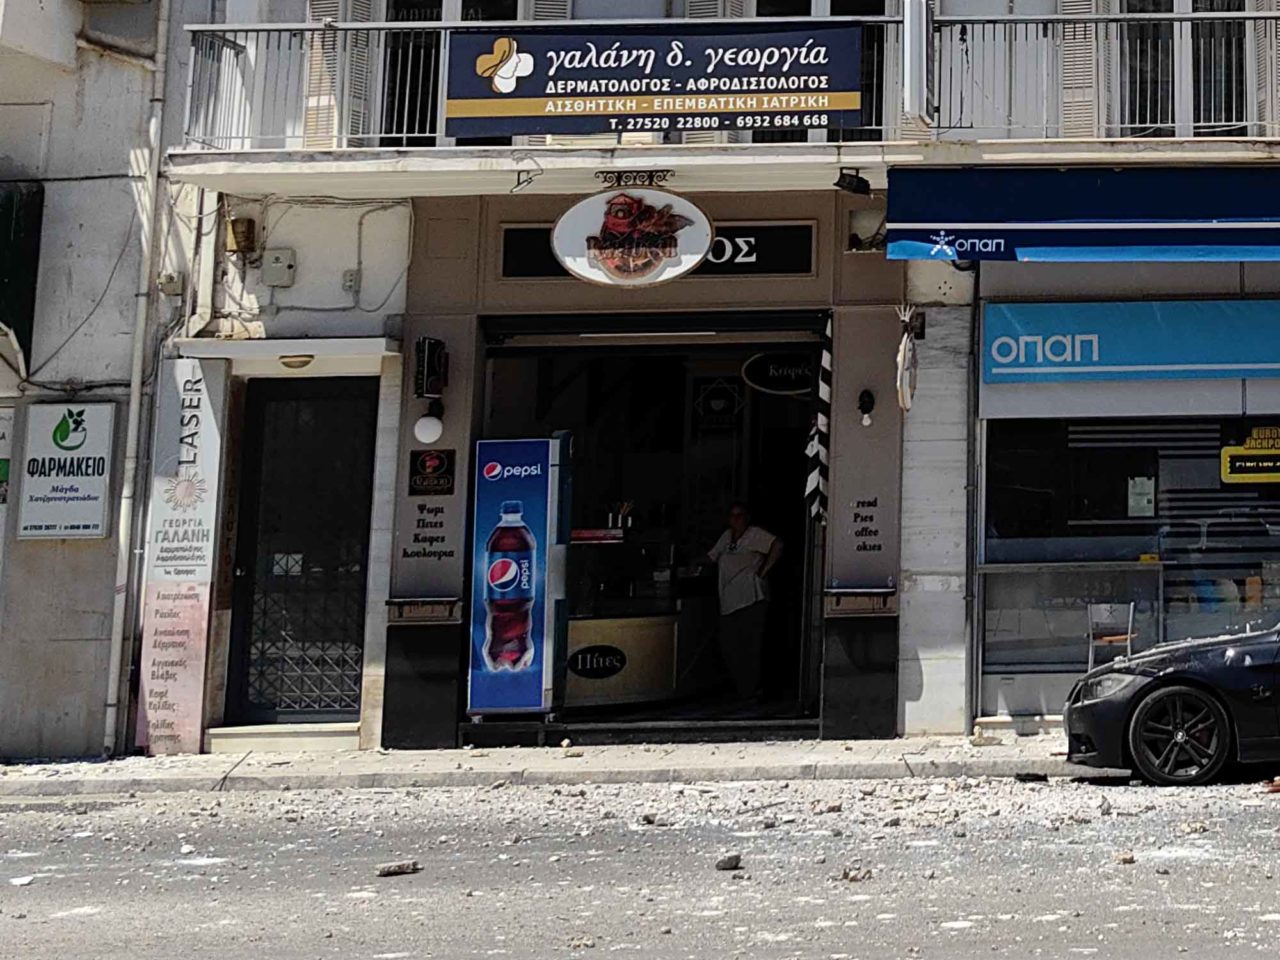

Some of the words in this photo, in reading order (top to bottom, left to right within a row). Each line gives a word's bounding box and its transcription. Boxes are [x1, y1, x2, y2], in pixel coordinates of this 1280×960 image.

[546, 42, 656, 76] γαλάνη
[666, 41, 692, 67] δ.
[705, 39, 829, 73] γεωργία
[545, 79, 671, 94] ΔΕΡΜΑΤΟΛΟΓΟΣ
[686, 76, 829, 91] ΑΦΡΟΔΙΣΙΟΛΟΓΟΣ
[545, 99, 637, 112] ΑΙΣΘΗΤΙΚΗ
[653, 97, 757, 110] ΕΠΕΜΒΑΤΙΚΗ
[762, 96, 829, 108] ΙΑΤΡΙΚΗ
[609, 118, 622, 129] Τ.
[627, 118, 669, 129] 27520
[676, 117, 719, 128] 22800
[736, 116, 770, 127] 6932
[774, 115, 799, 126] 684
[803, 114, 829, 125] 668
[178, 377, 203, 466] LASER
[27, 456, 106, 478] ΦΑΡΜΑΚΕΙΟ
[503, 464, 542, 478] pepsi
[162, 519, 203, 528] ΓΕΩΡΓΙΑ
[155, 529, 210, 543] ΓΑΛΑΝΗ
[520, 559, 530, 589] pepsi
[577, 652, 621, 670] Πίτες
